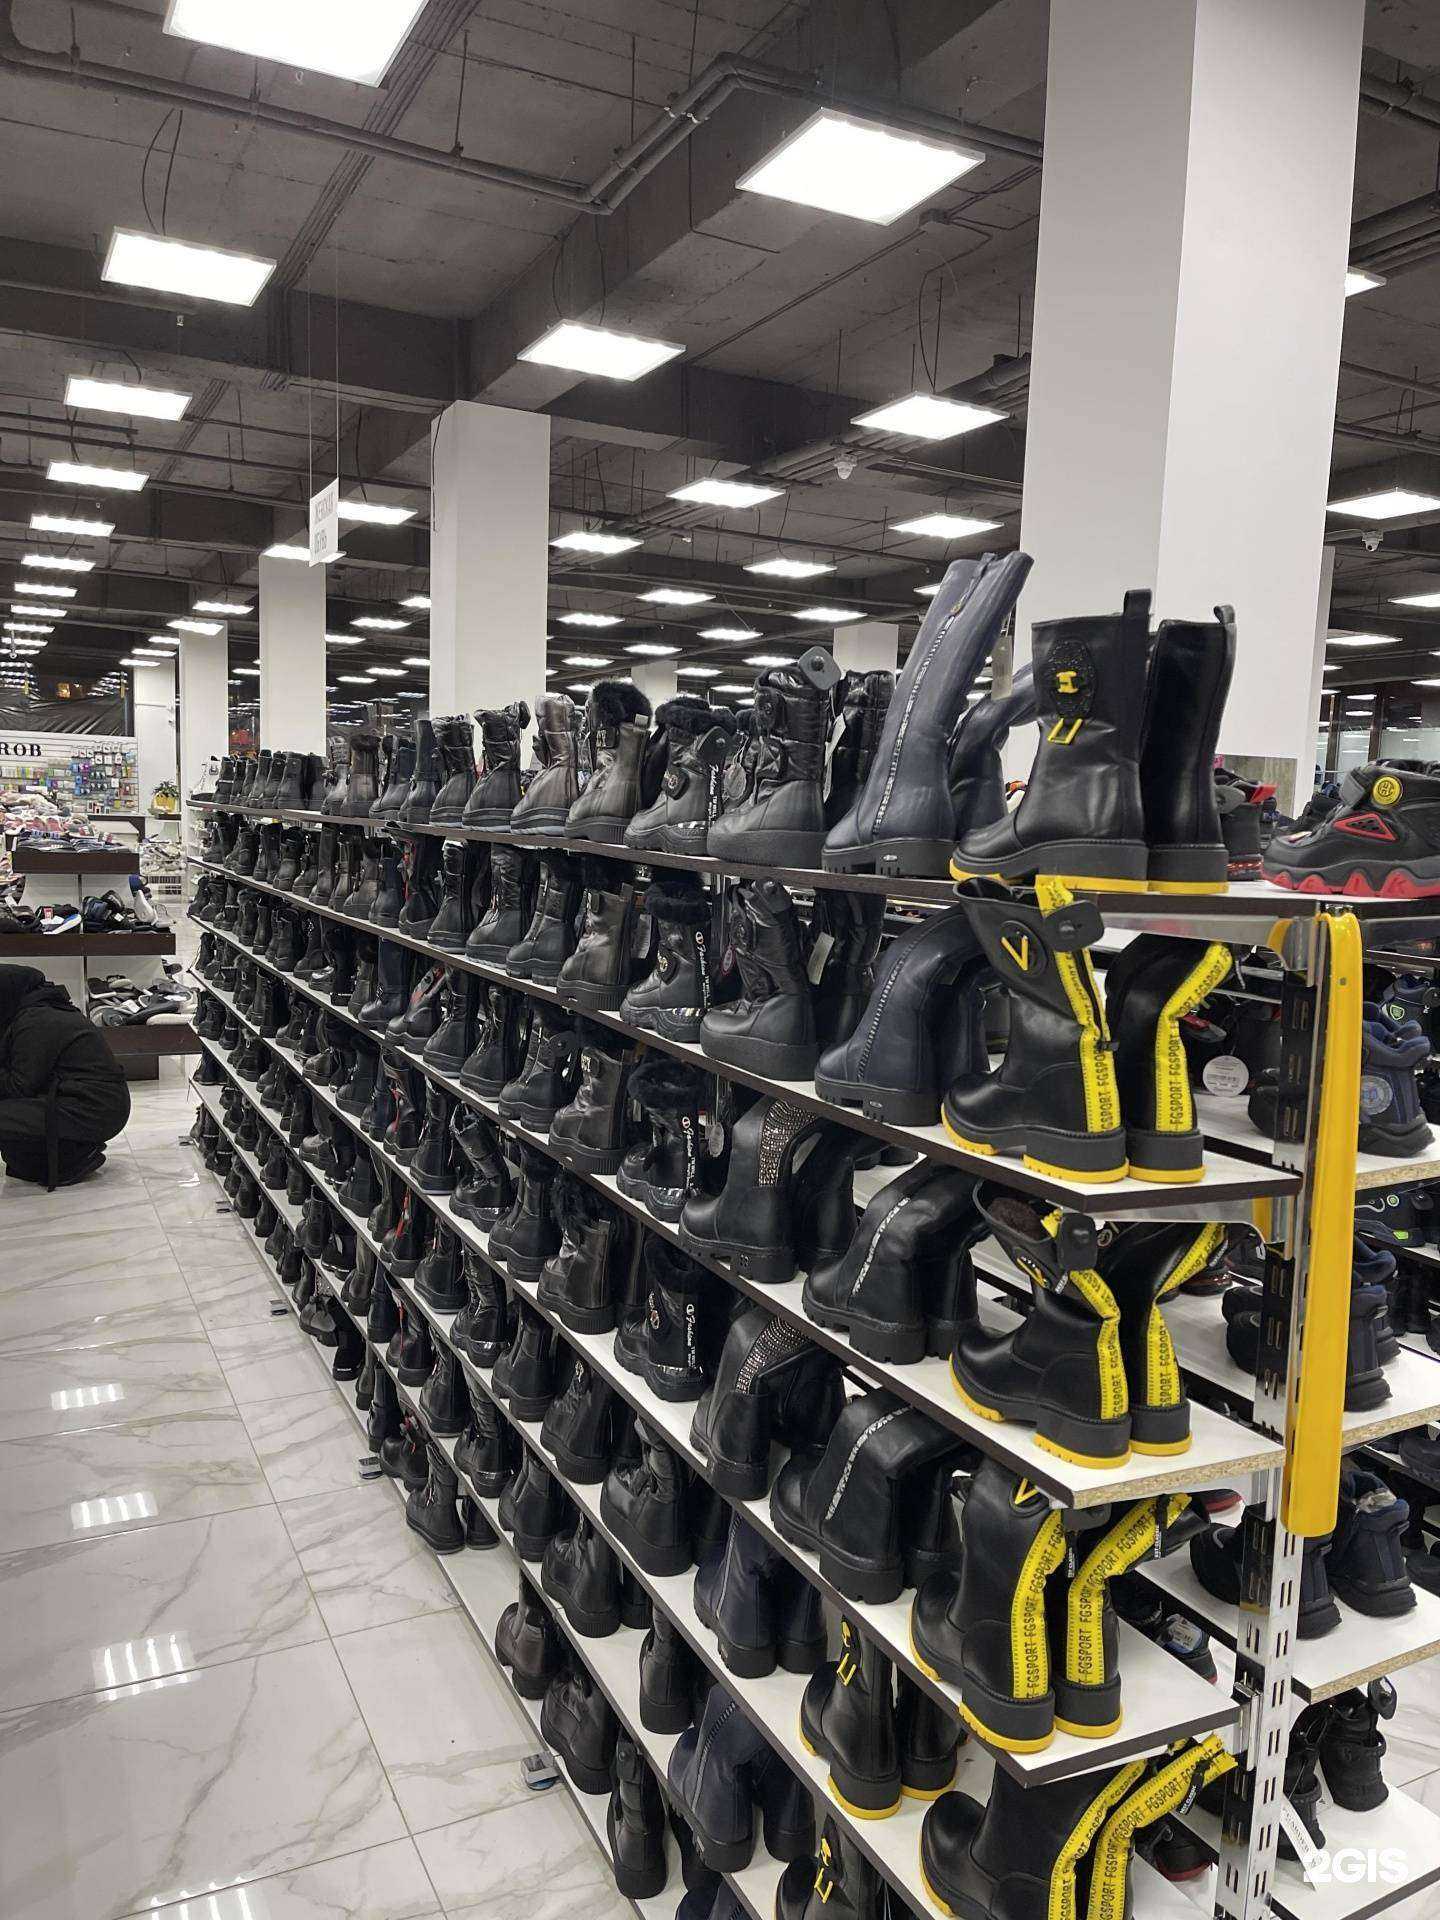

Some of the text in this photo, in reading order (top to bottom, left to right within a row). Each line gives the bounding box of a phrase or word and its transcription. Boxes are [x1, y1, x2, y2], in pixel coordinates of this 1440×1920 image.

[1168, 1034, 1182, 1077] FGSPORT
[1169, 1080, 1184, 1126] FGSPORT
[1116, 1515, 1150, 1551] FGSPORT
[1030, 1549, 1058, 1594] FGSPORT
[1024, 1637, 1040, 1689] FGSPORT
[1078, 1628, 1094, 1676] FGSPORT
[1146, 1777, 1184, 1814] FGSPORT
